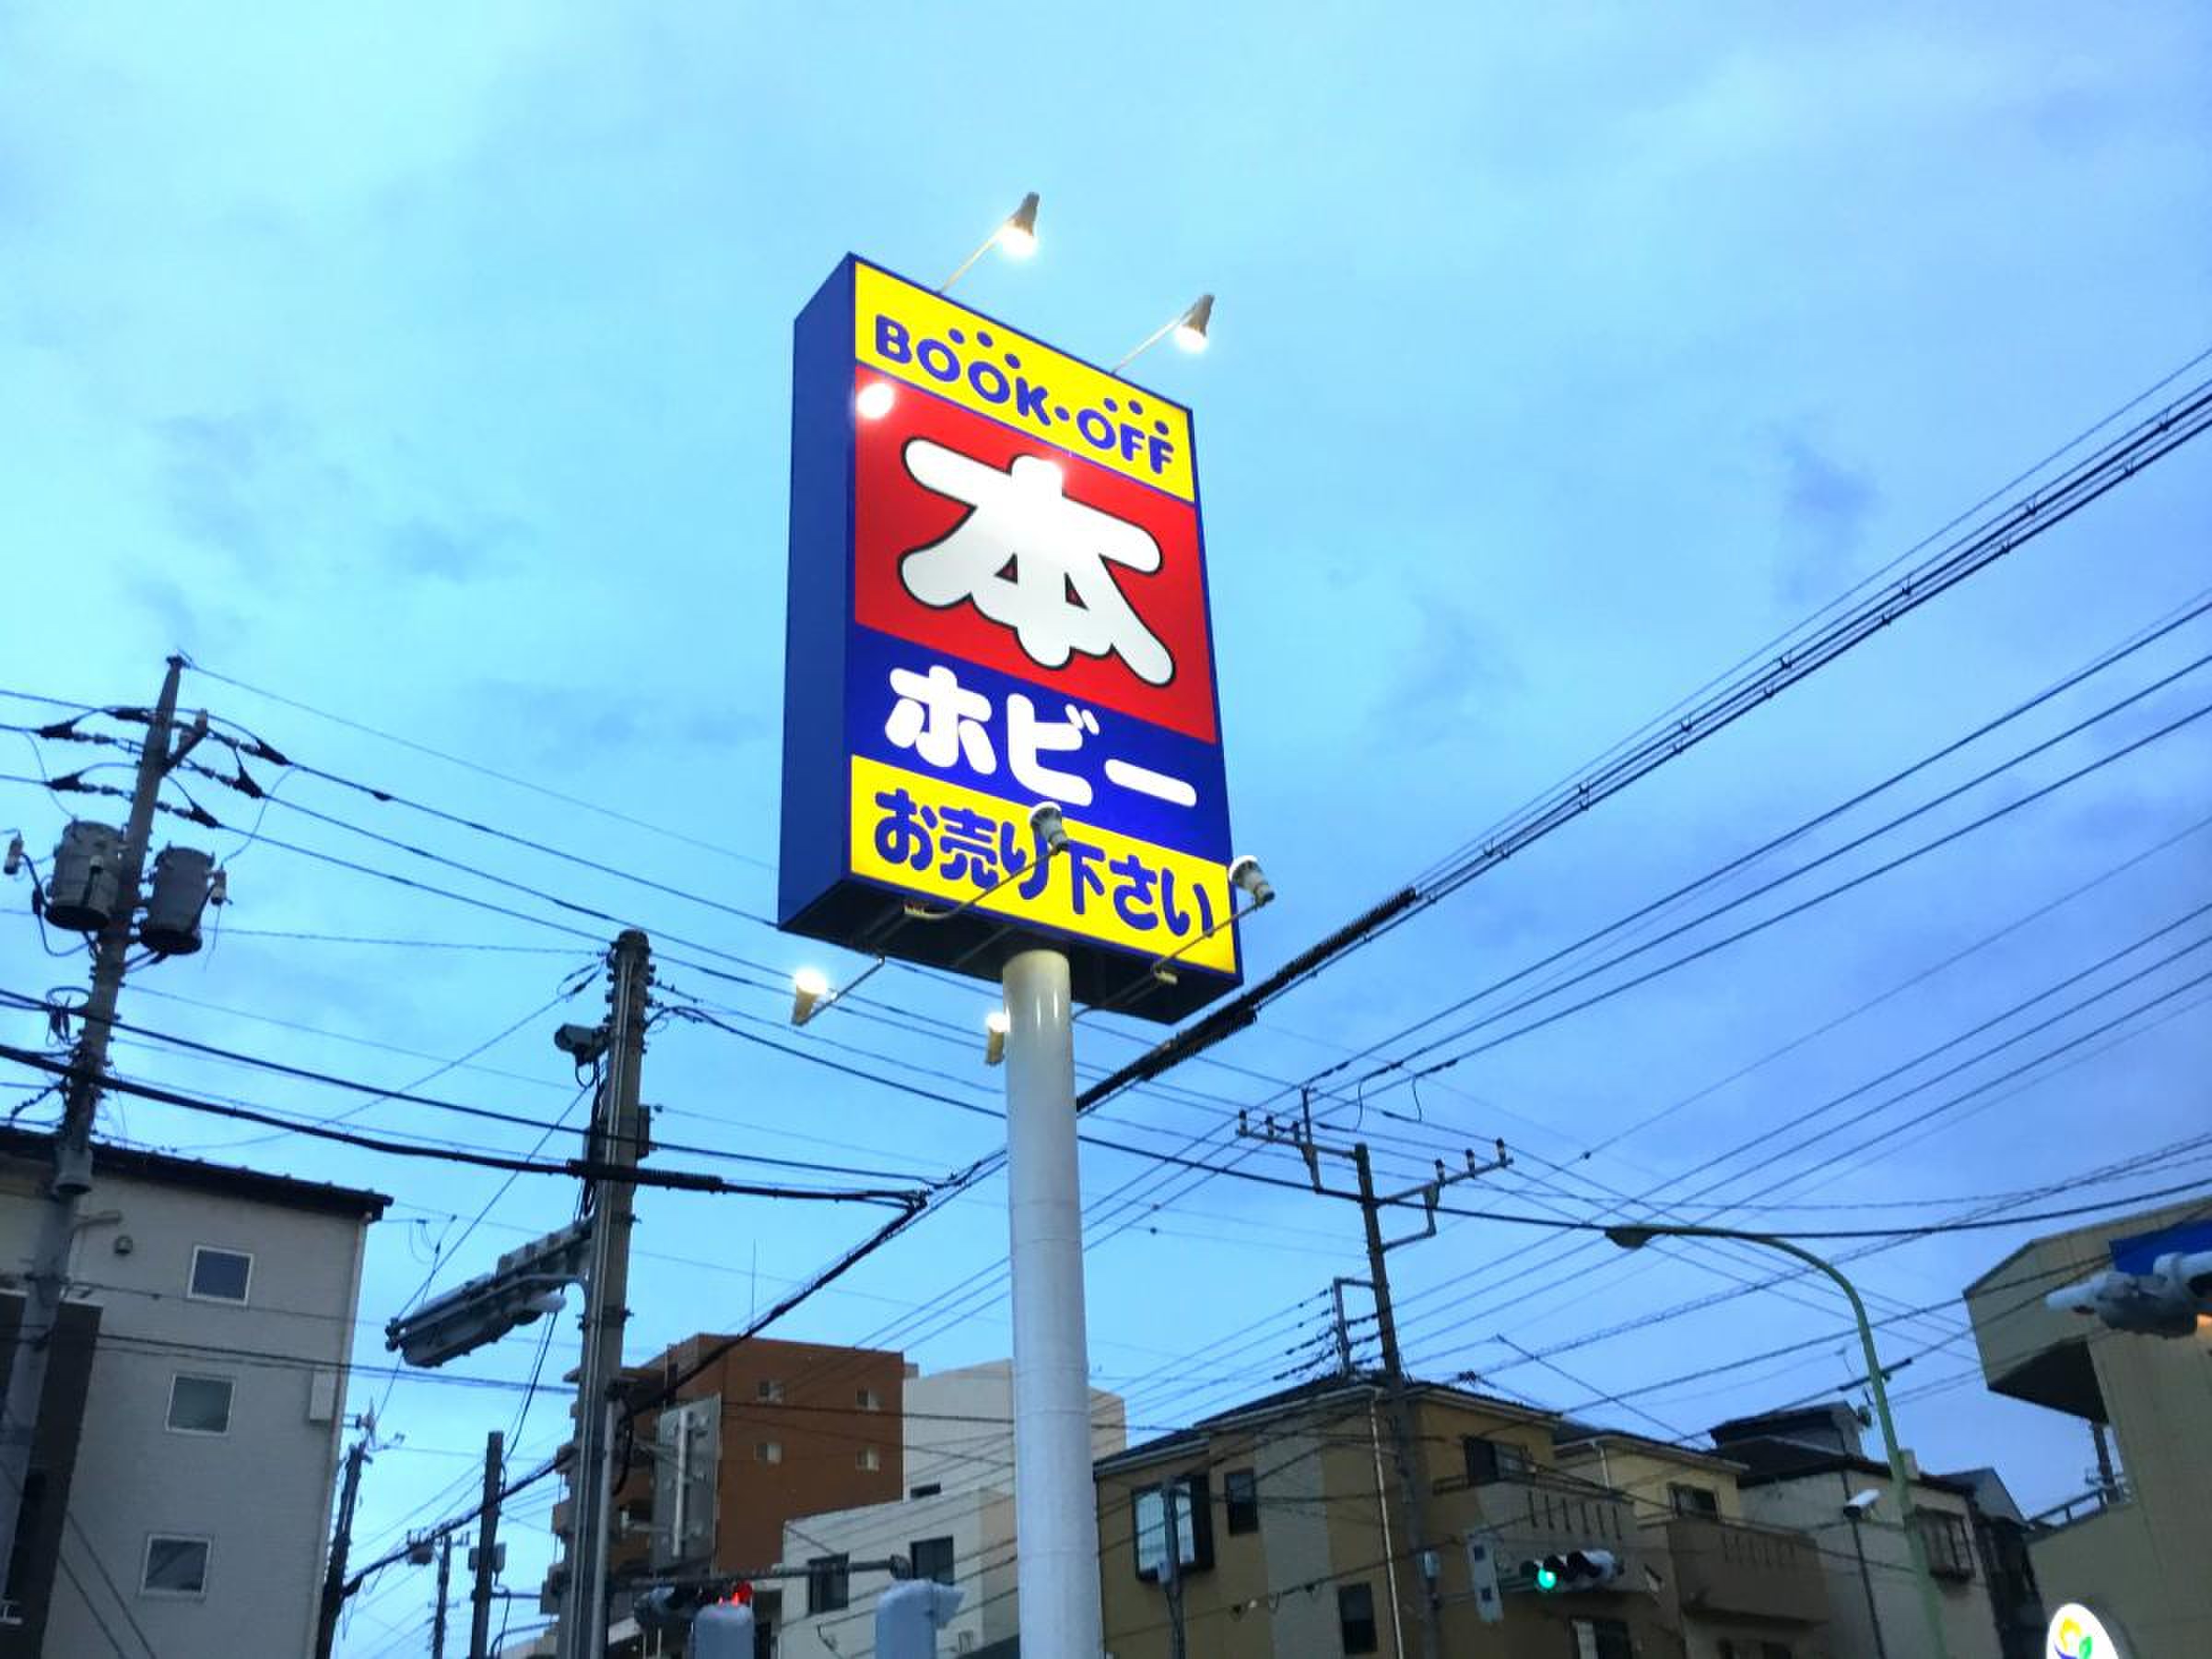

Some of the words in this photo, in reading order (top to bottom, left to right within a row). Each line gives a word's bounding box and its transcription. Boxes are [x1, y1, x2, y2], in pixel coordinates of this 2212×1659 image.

[898, 437, 1176, 688] 本
[885, 665, 1196, 807] ホビー
[874, 789, 1215, 937] お売り下さい
